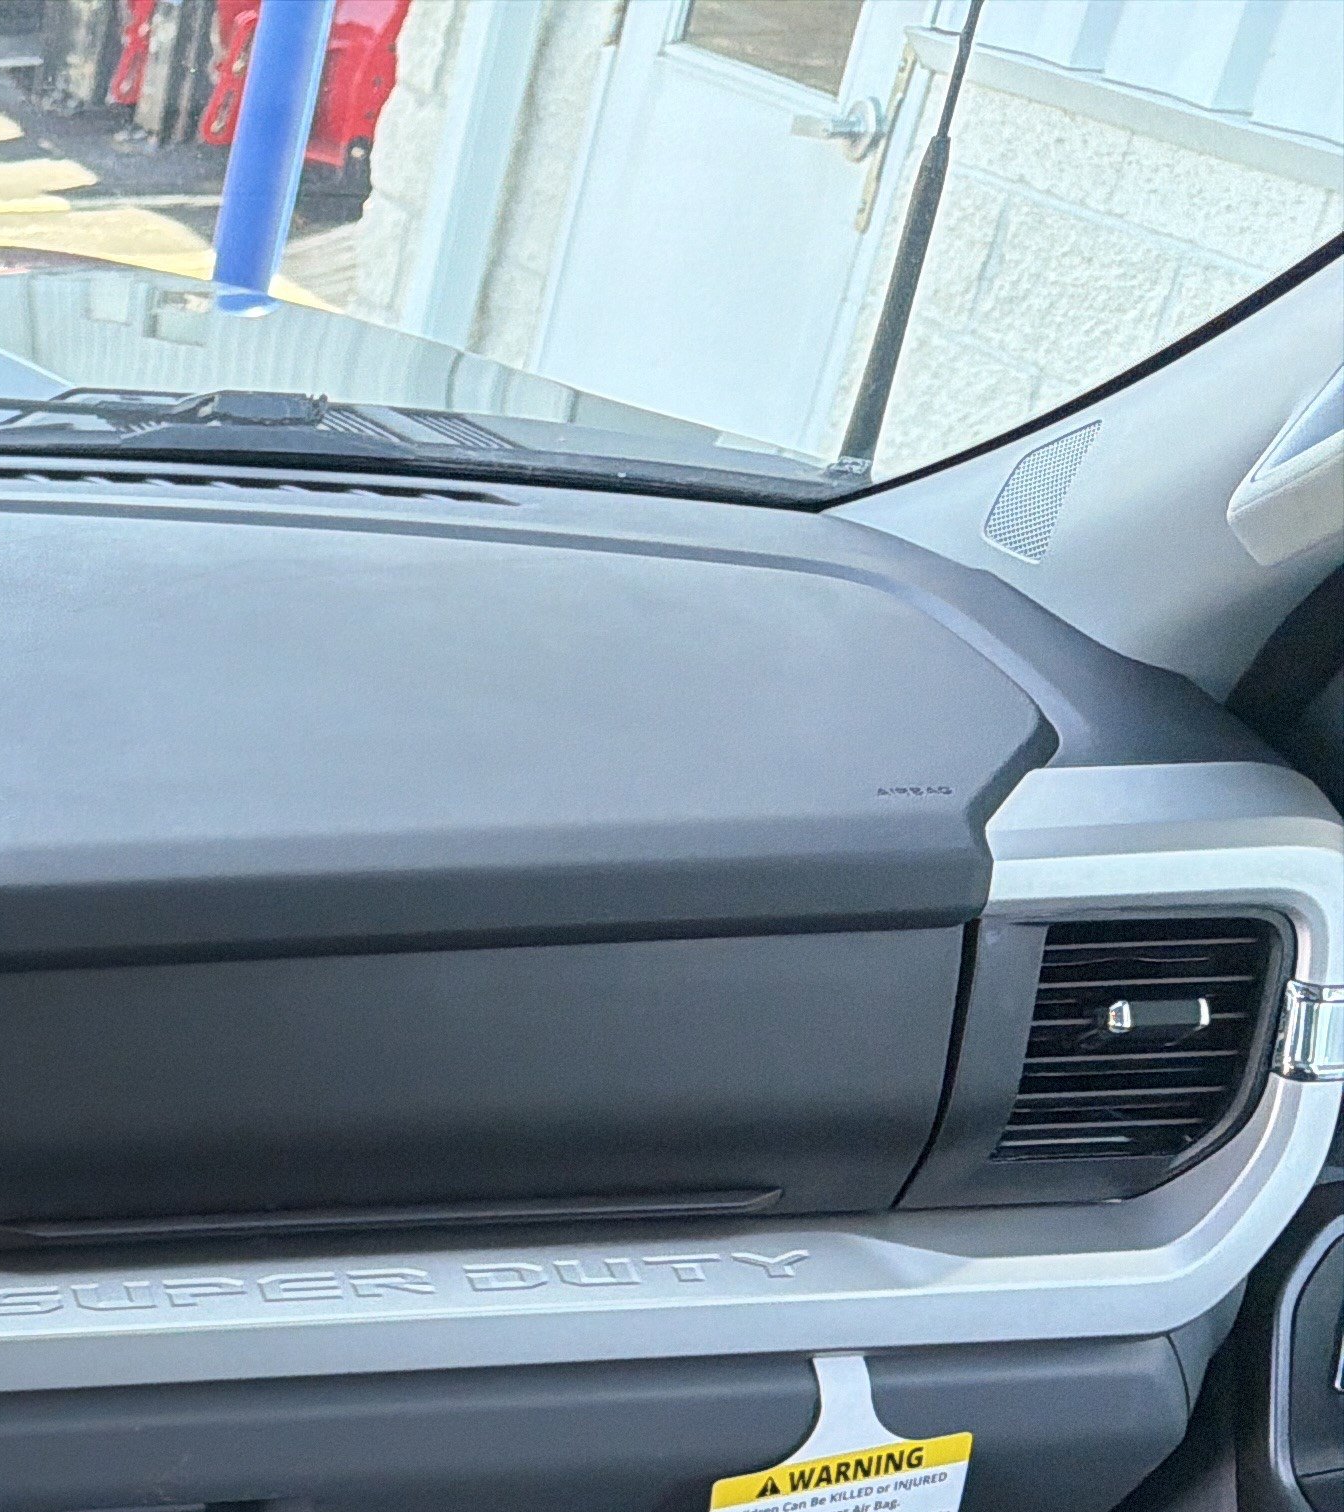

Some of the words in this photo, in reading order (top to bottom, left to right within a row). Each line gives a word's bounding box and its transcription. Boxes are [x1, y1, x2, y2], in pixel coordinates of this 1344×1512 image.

[462, 1249, 810, 1292] DUTY
[789, 1446, 924, 1493] WARNING
[782, 1499, 807, 1512] Can
[810, 1496, 827, 1508] Be
[829, 1486, 874, 1503] KILLED
[876, 1483, 891, 1494] or
[893, 1471, 948, 1491] INJURED
[873, 1499, 901, 1512] Bag.
